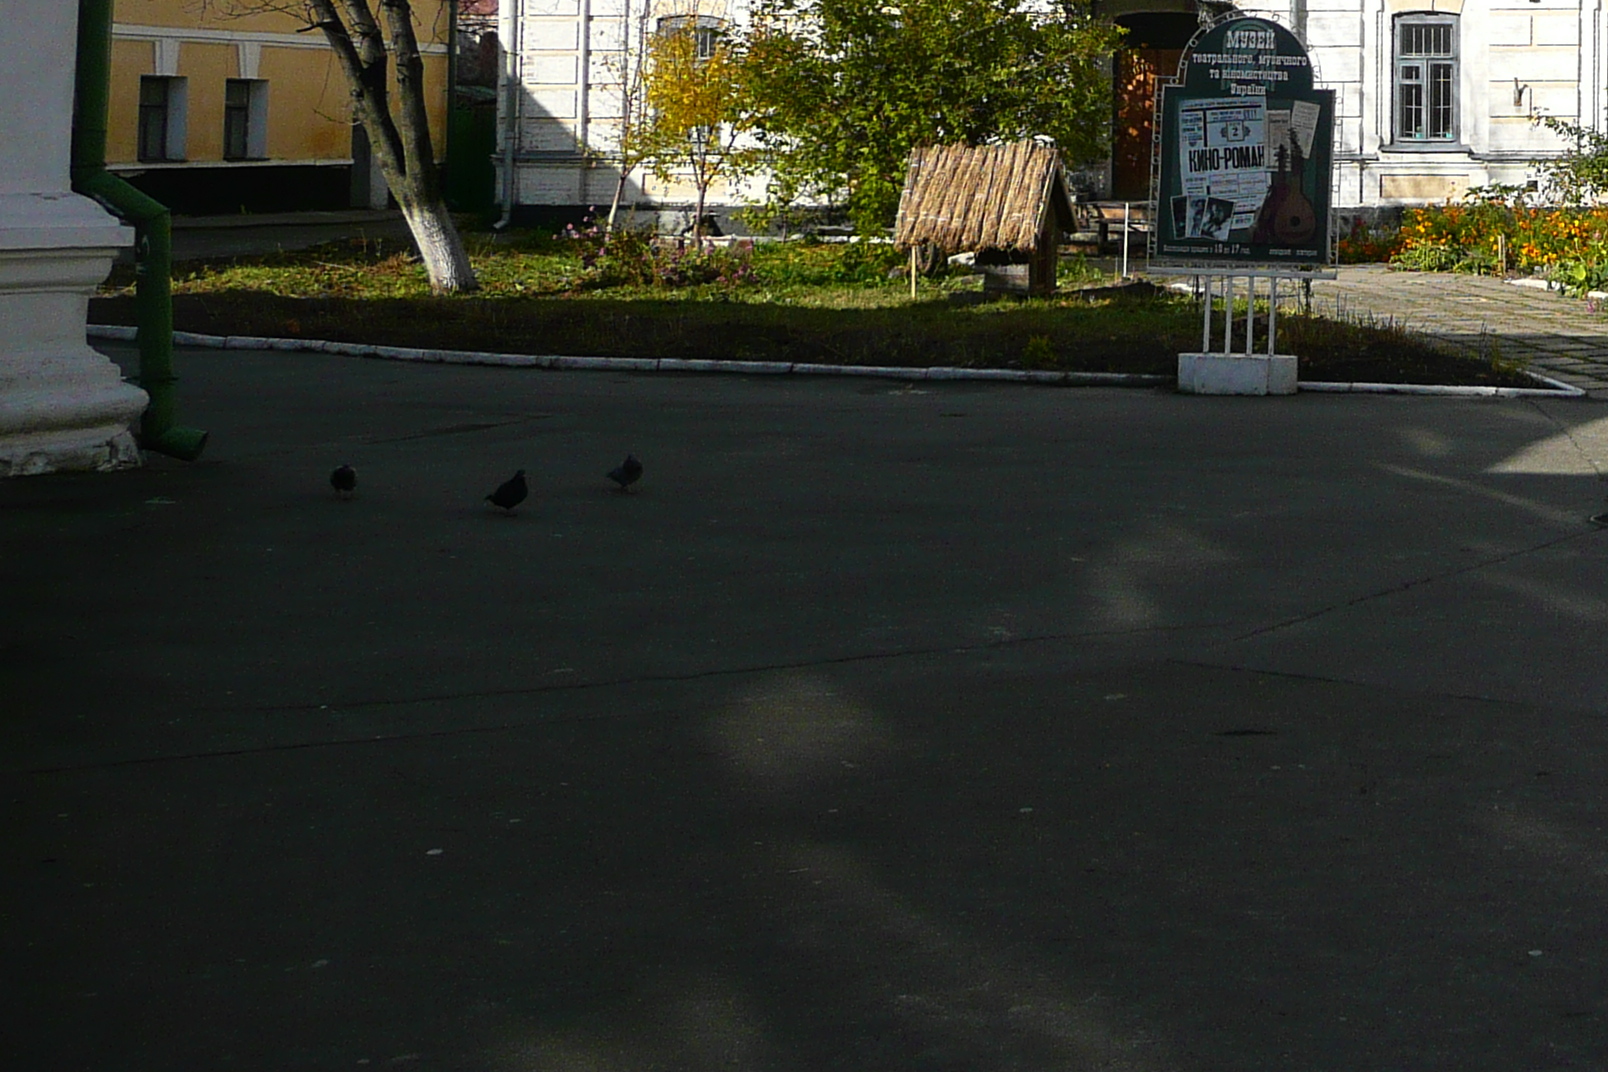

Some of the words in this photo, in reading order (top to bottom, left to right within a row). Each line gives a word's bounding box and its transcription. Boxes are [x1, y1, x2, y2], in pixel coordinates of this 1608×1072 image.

[1226, 28, 1275, 49] МУЗЕЙ
[1192, 53, 1255, 65] театрального,
[1258, 55, 1307, 66] музичного
[1209, 69, 1220, 79] та
[1230, 83, 1266, 96] України
[1189, 145, 1265, 173] КИНО-РОМАН
